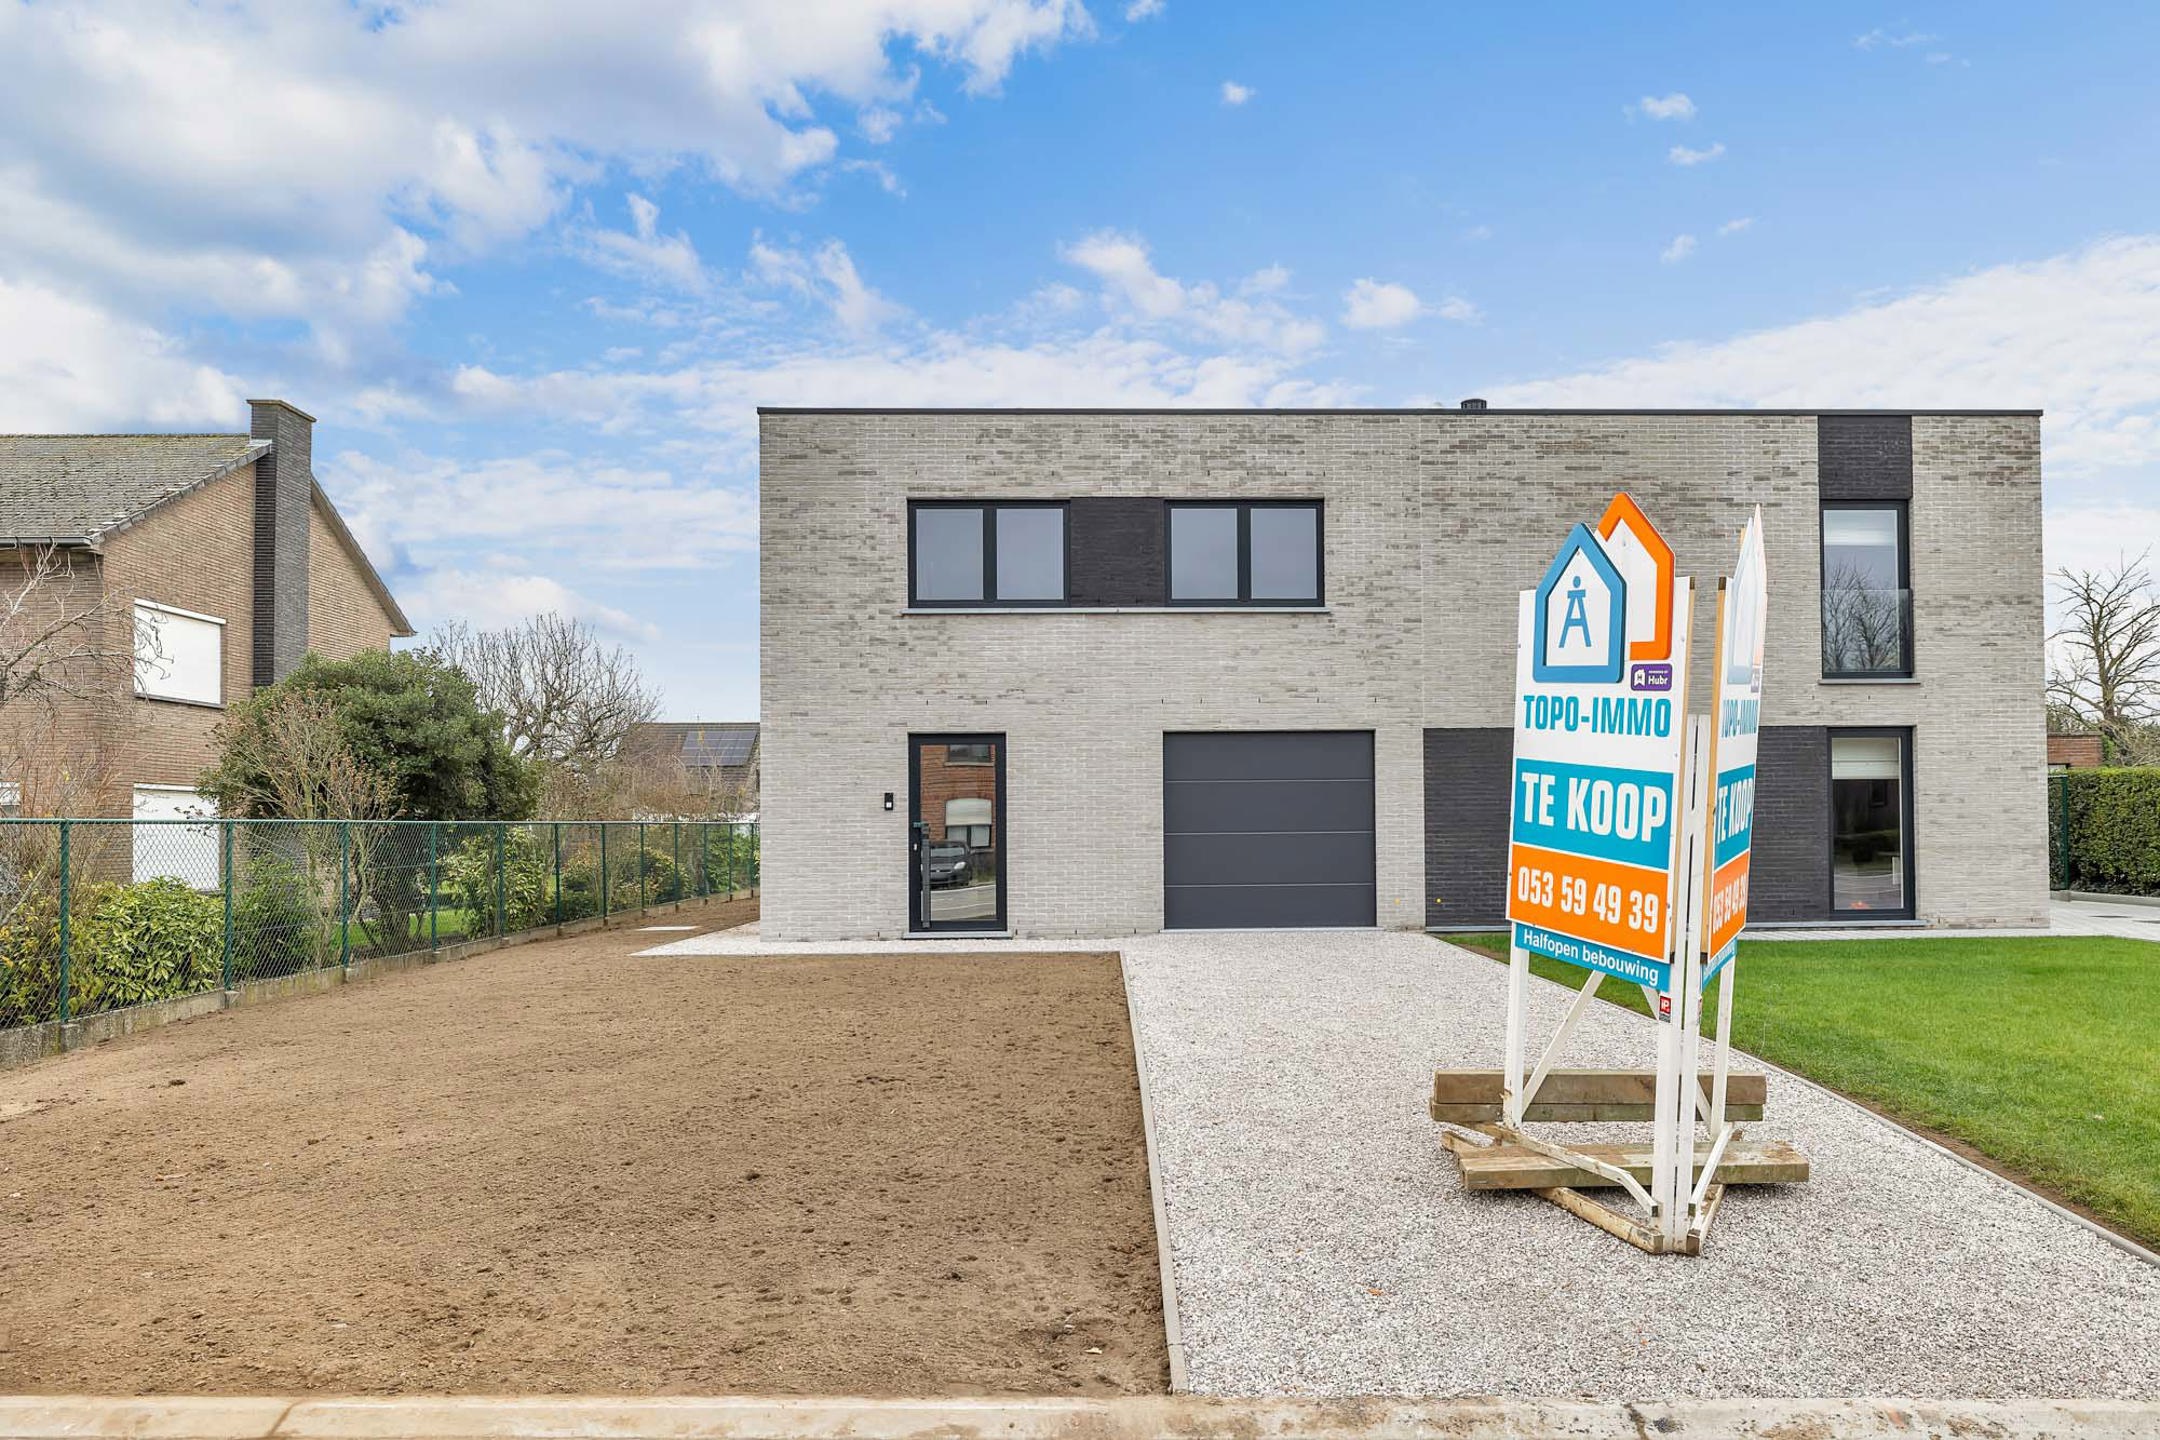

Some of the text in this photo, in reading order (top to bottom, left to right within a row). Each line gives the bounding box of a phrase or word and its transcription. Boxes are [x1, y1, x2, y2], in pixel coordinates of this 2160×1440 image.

[1648, 675, 1668, 685] Hubr
[1523, 695, 1672, 738] TOPO-IMMO
[1521, 772, 1668, 843] TE KOOP
[1717, 778, 1753, 844] TE KOOP
[1517, 866, 1660, 934] 053 59 49 39
[1523, 928, 1660, 986] Halfopen bebouwing
